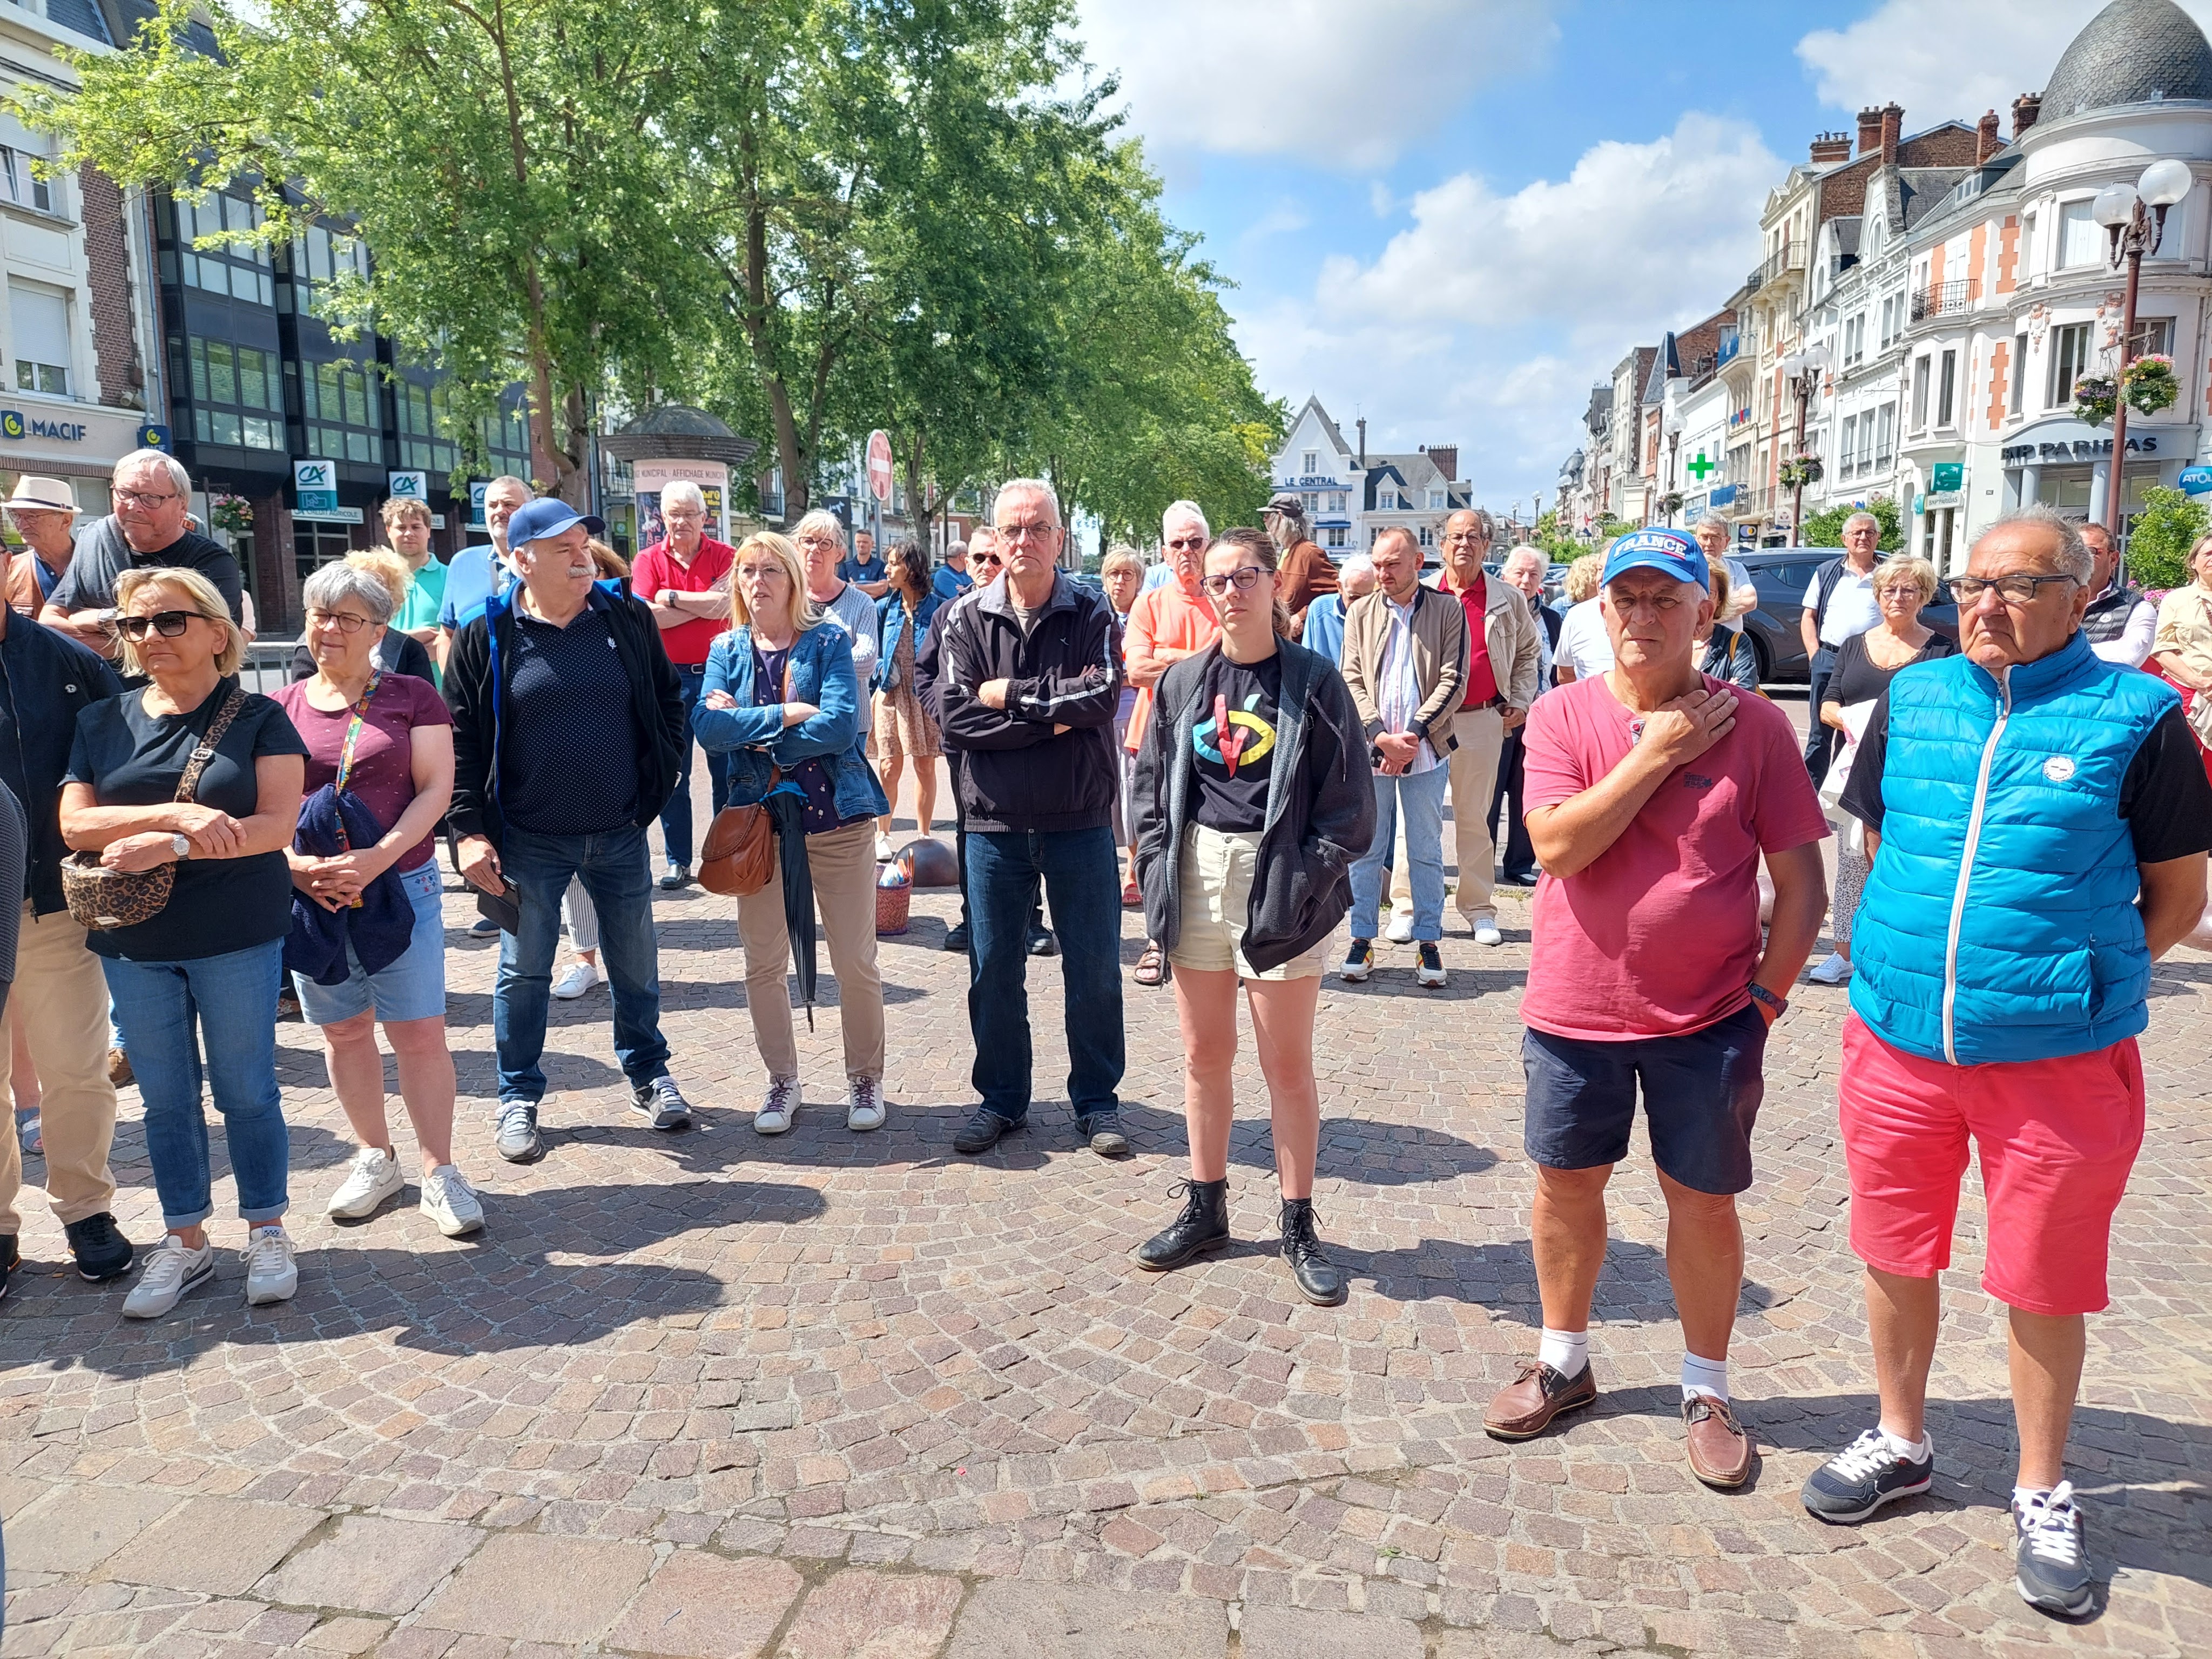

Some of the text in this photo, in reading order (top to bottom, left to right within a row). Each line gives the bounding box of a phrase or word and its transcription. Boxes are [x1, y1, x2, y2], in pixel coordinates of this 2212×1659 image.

[31, 417, 87, 442] MACIF
[2000, 437, 2158, 461] BNP PARIBAS
[642, 469, 667, 477] MUNICIPAL
[673, 469, 704, 478] AFFICHAGE
[1285, 476, 1338, 487] LE CENTRAL
[1614, 535, 1688, 557] FRANCE
